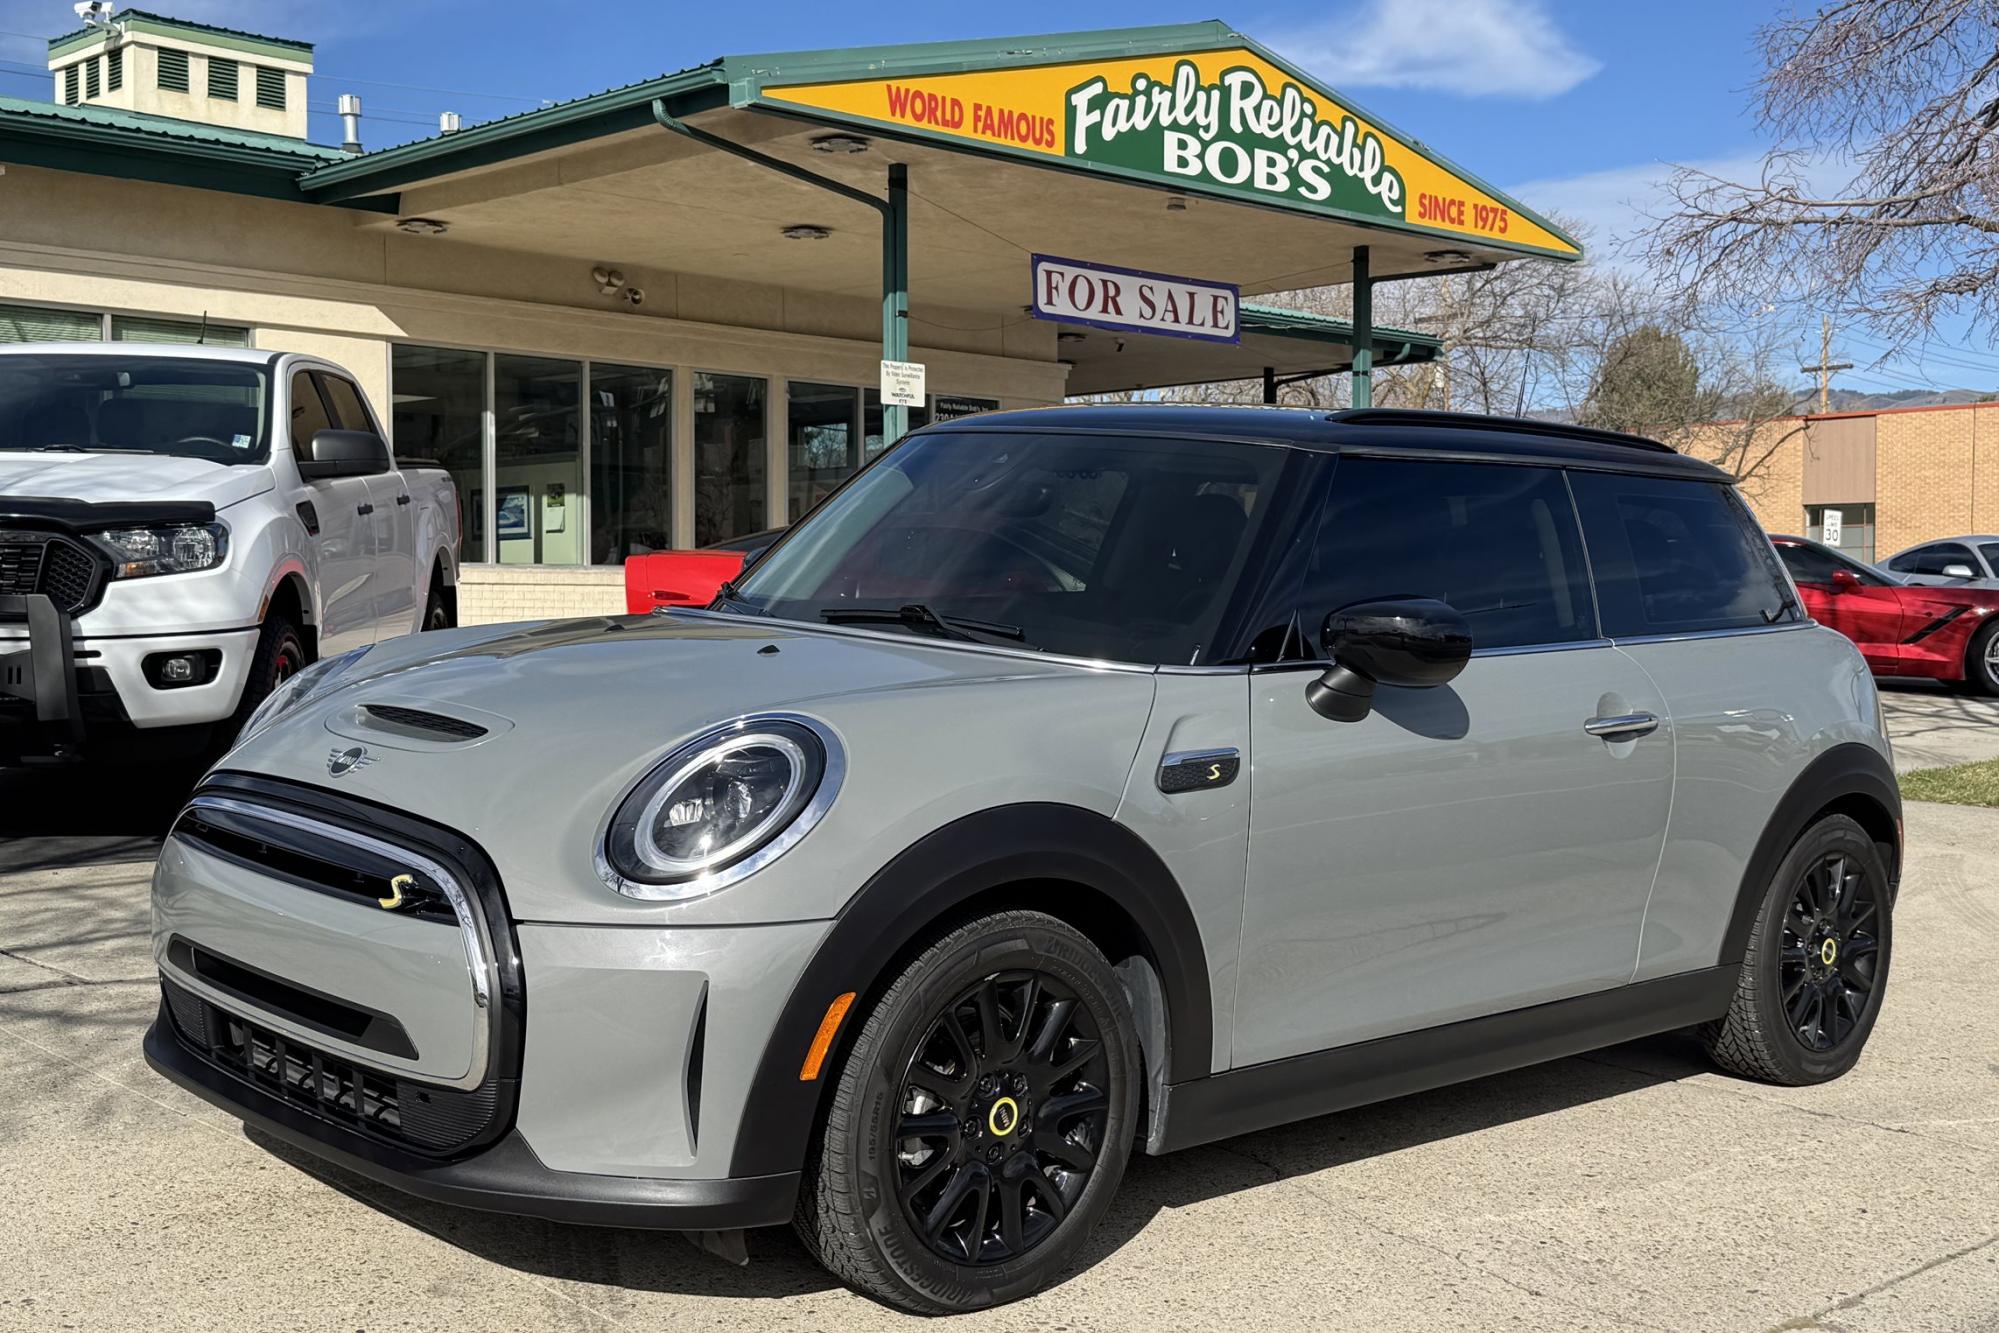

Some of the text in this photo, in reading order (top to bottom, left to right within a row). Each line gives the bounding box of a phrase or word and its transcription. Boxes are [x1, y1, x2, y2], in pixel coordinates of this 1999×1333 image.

[886, 84, 1056, 149] WORLD FAMOUS
[1071, 65, 1403, 213] Fairly Reliable
[1163, 130, 1332, 201] BOB'S
[1418, 192, 1508, 234] SINCE 1975
[1043, 269, 1231, 330] FOR SALE
[1825, 528, 1839, 541] 30
[1206, 763, 1221, 780] S
[378, 873, 414, 909] S
